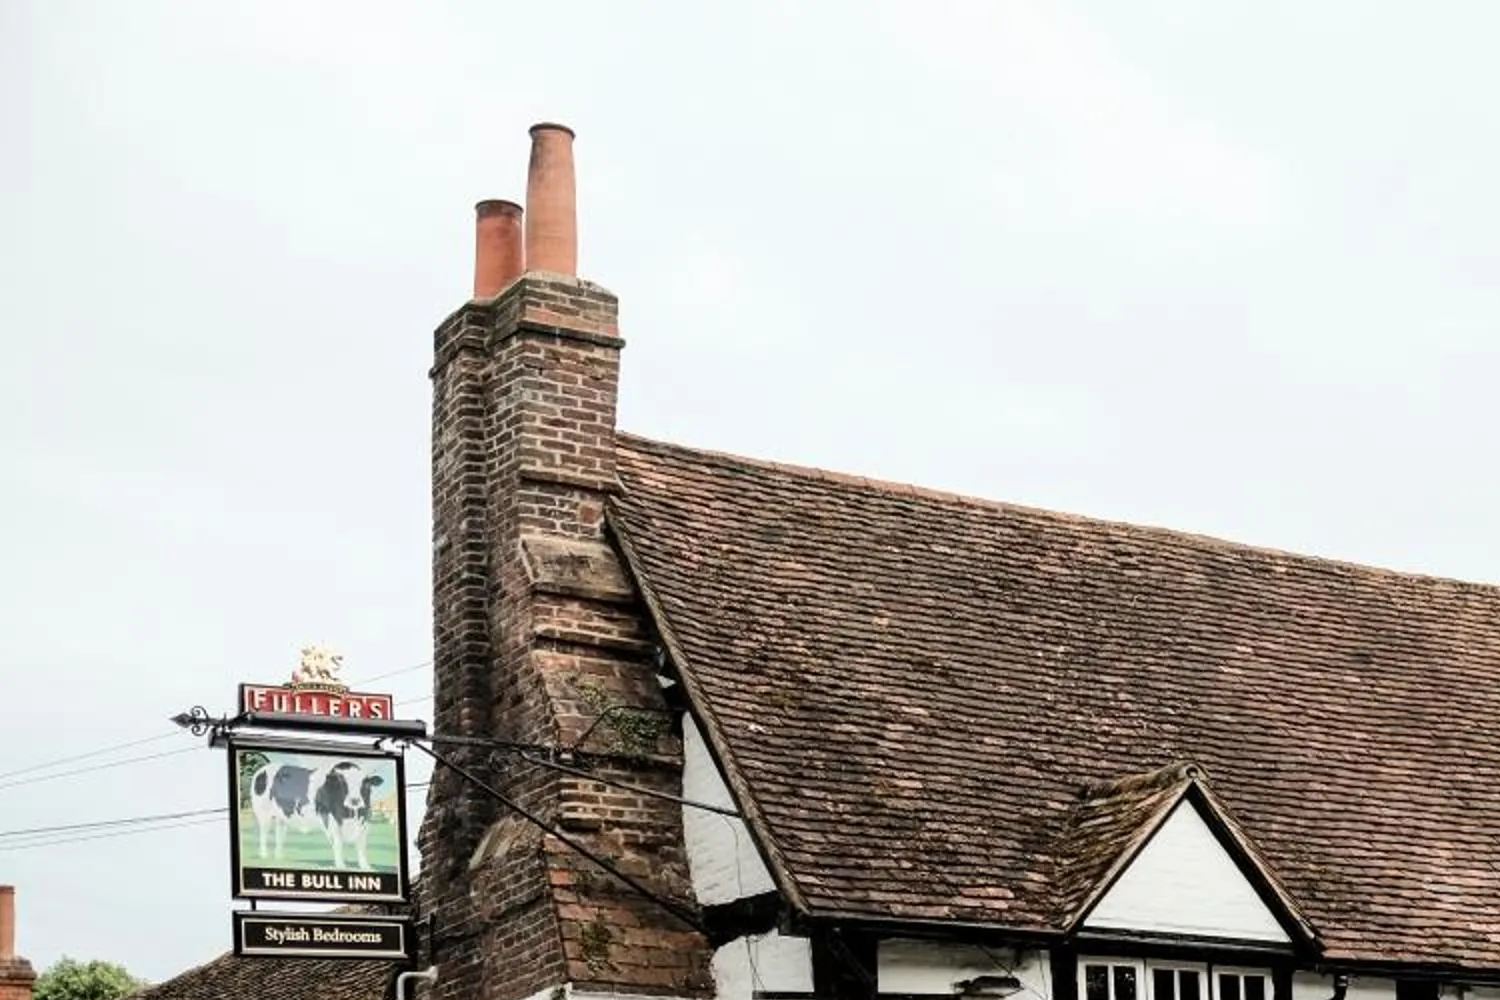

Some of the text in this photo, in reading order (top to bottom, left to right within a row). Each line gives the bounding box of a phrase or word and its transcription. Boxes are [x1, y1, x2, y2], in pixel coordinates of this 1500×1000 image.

[253, 688, 383, 721] FULLER'S
[262, 872, 381, 890] THE BULL INN
[265, 926, 382, 944] Stylish Bedrooms
